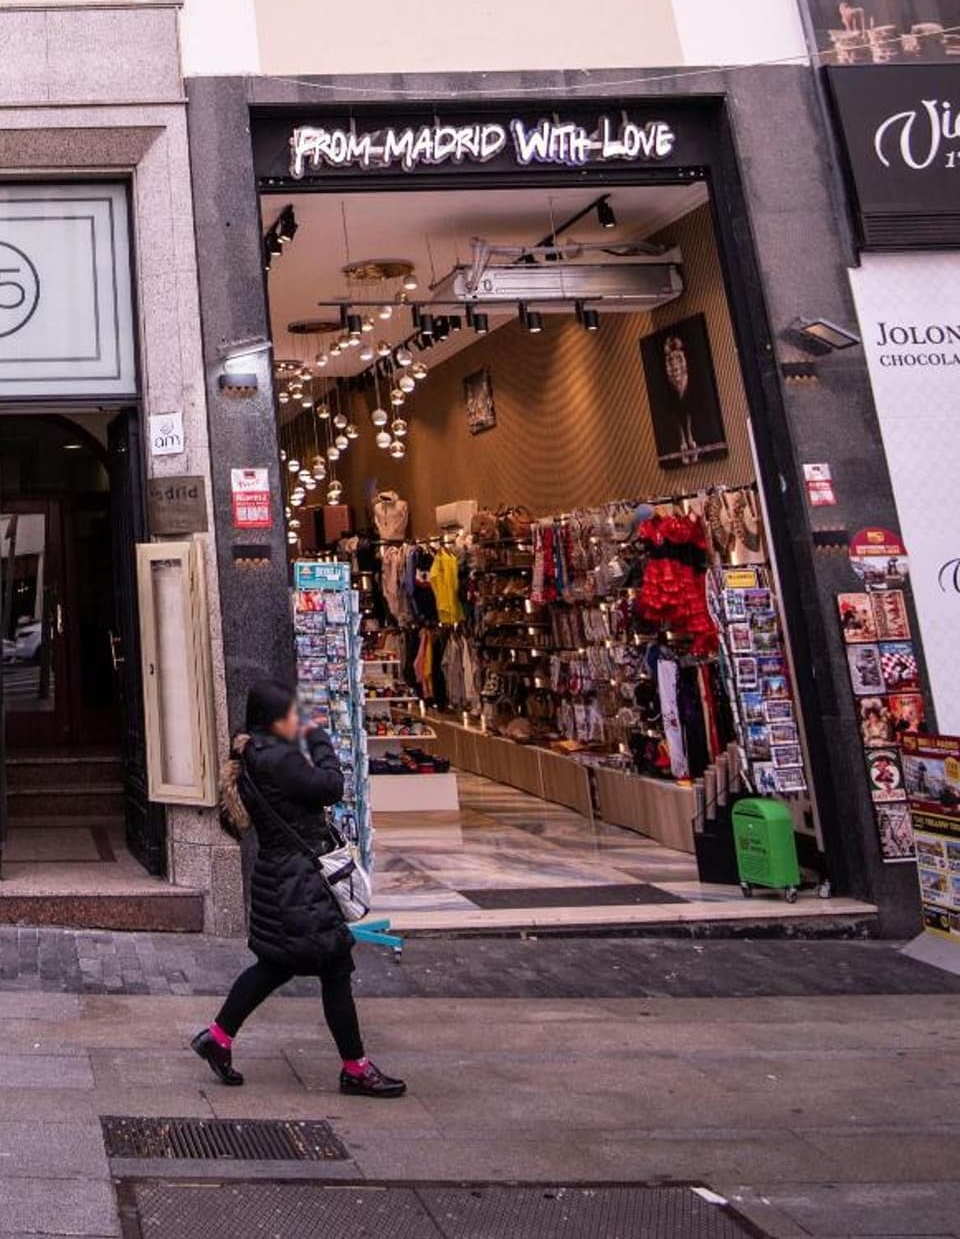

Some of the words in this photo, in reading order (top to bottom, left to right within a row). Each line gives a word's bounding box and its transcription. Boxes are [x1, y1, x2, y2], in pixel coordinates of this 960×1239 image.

[290, 126, 371, 178] FROM
[383, 124, 506, 171] MADRID
[511, 118, 587, 165] WITH
[601, 116, 675, 158] LOVE
[874, 99, 960, 169] Vi
